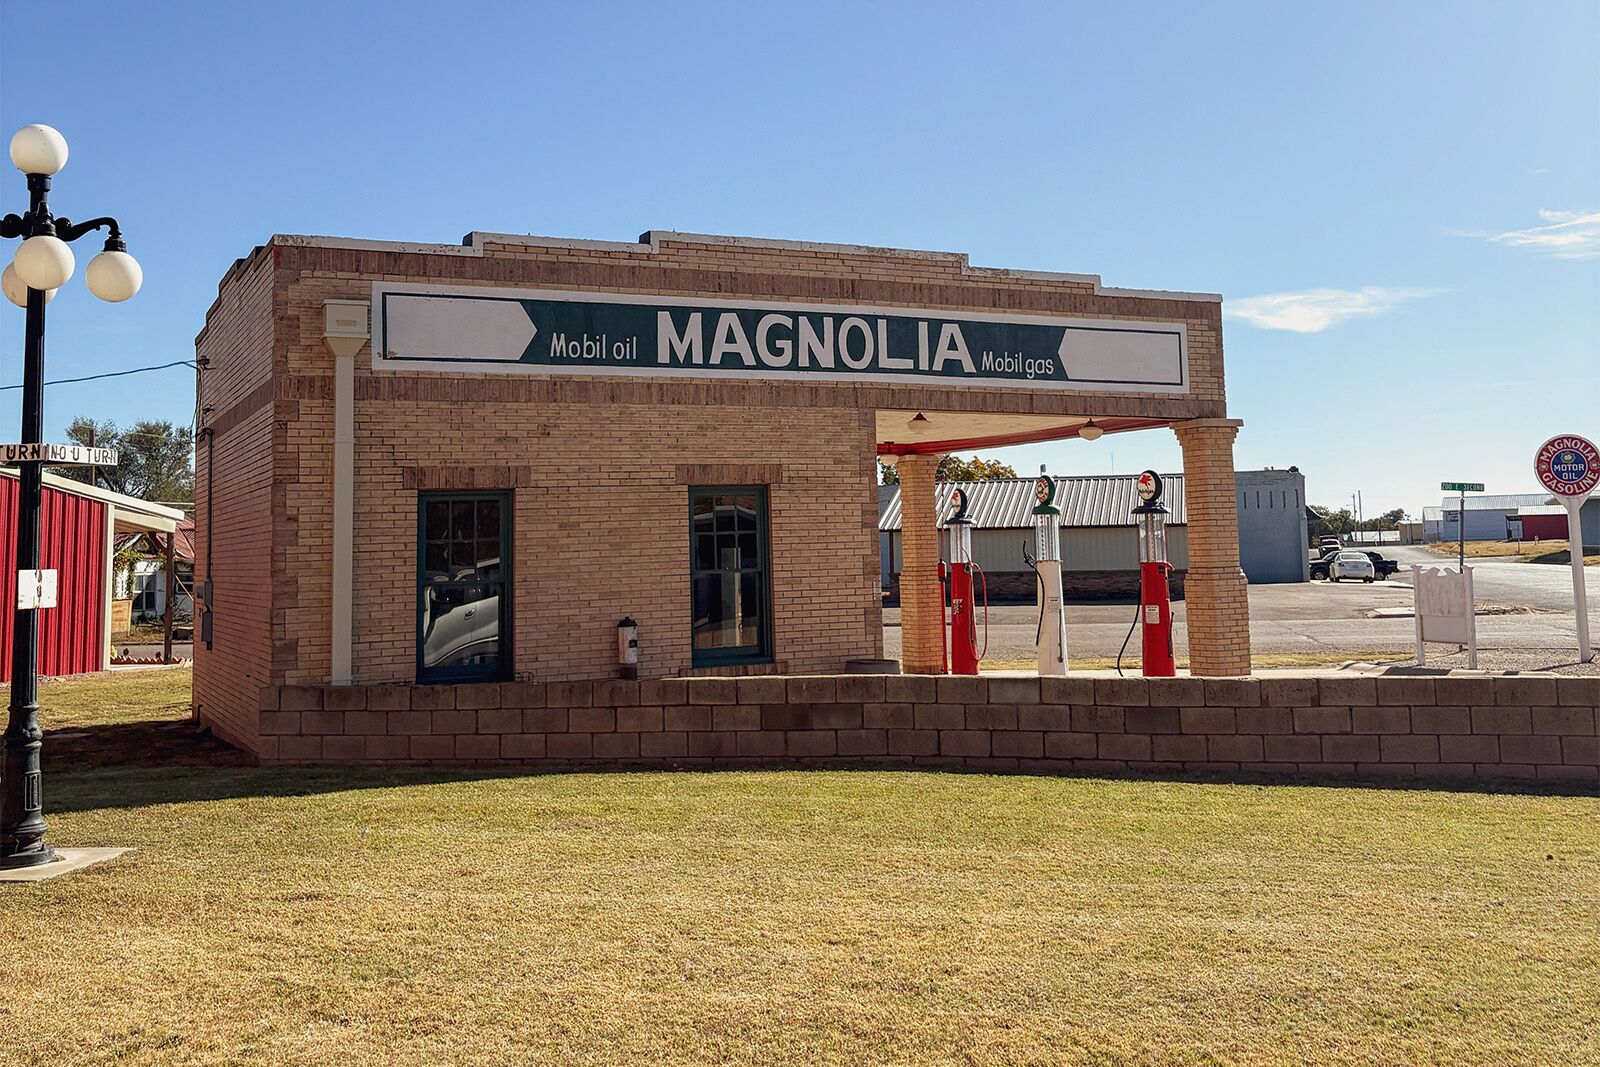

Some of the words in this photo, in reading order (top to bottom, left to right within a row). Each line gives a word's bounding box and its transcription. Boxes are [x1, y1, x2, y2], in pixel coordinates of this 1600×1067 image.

[550, 332, 606, 359] Mobil
[613, 335, 637, 360] oil
[656, 310, 977, 373] MAGNOLIA
[51, 445, 66, 460] NO
[72, 447, 80, 461] U
[87, 448, 117, 464] TURN
[1540, 438, 1596, 462] MAGNOLIA
[1553, 463, 1585, 472] MOTOR
[1562, 472, 1579, 480] OIL
[1463, 483, 1484, 491] SECOND
[1542, 471, 1598, 494] GASOLINE
